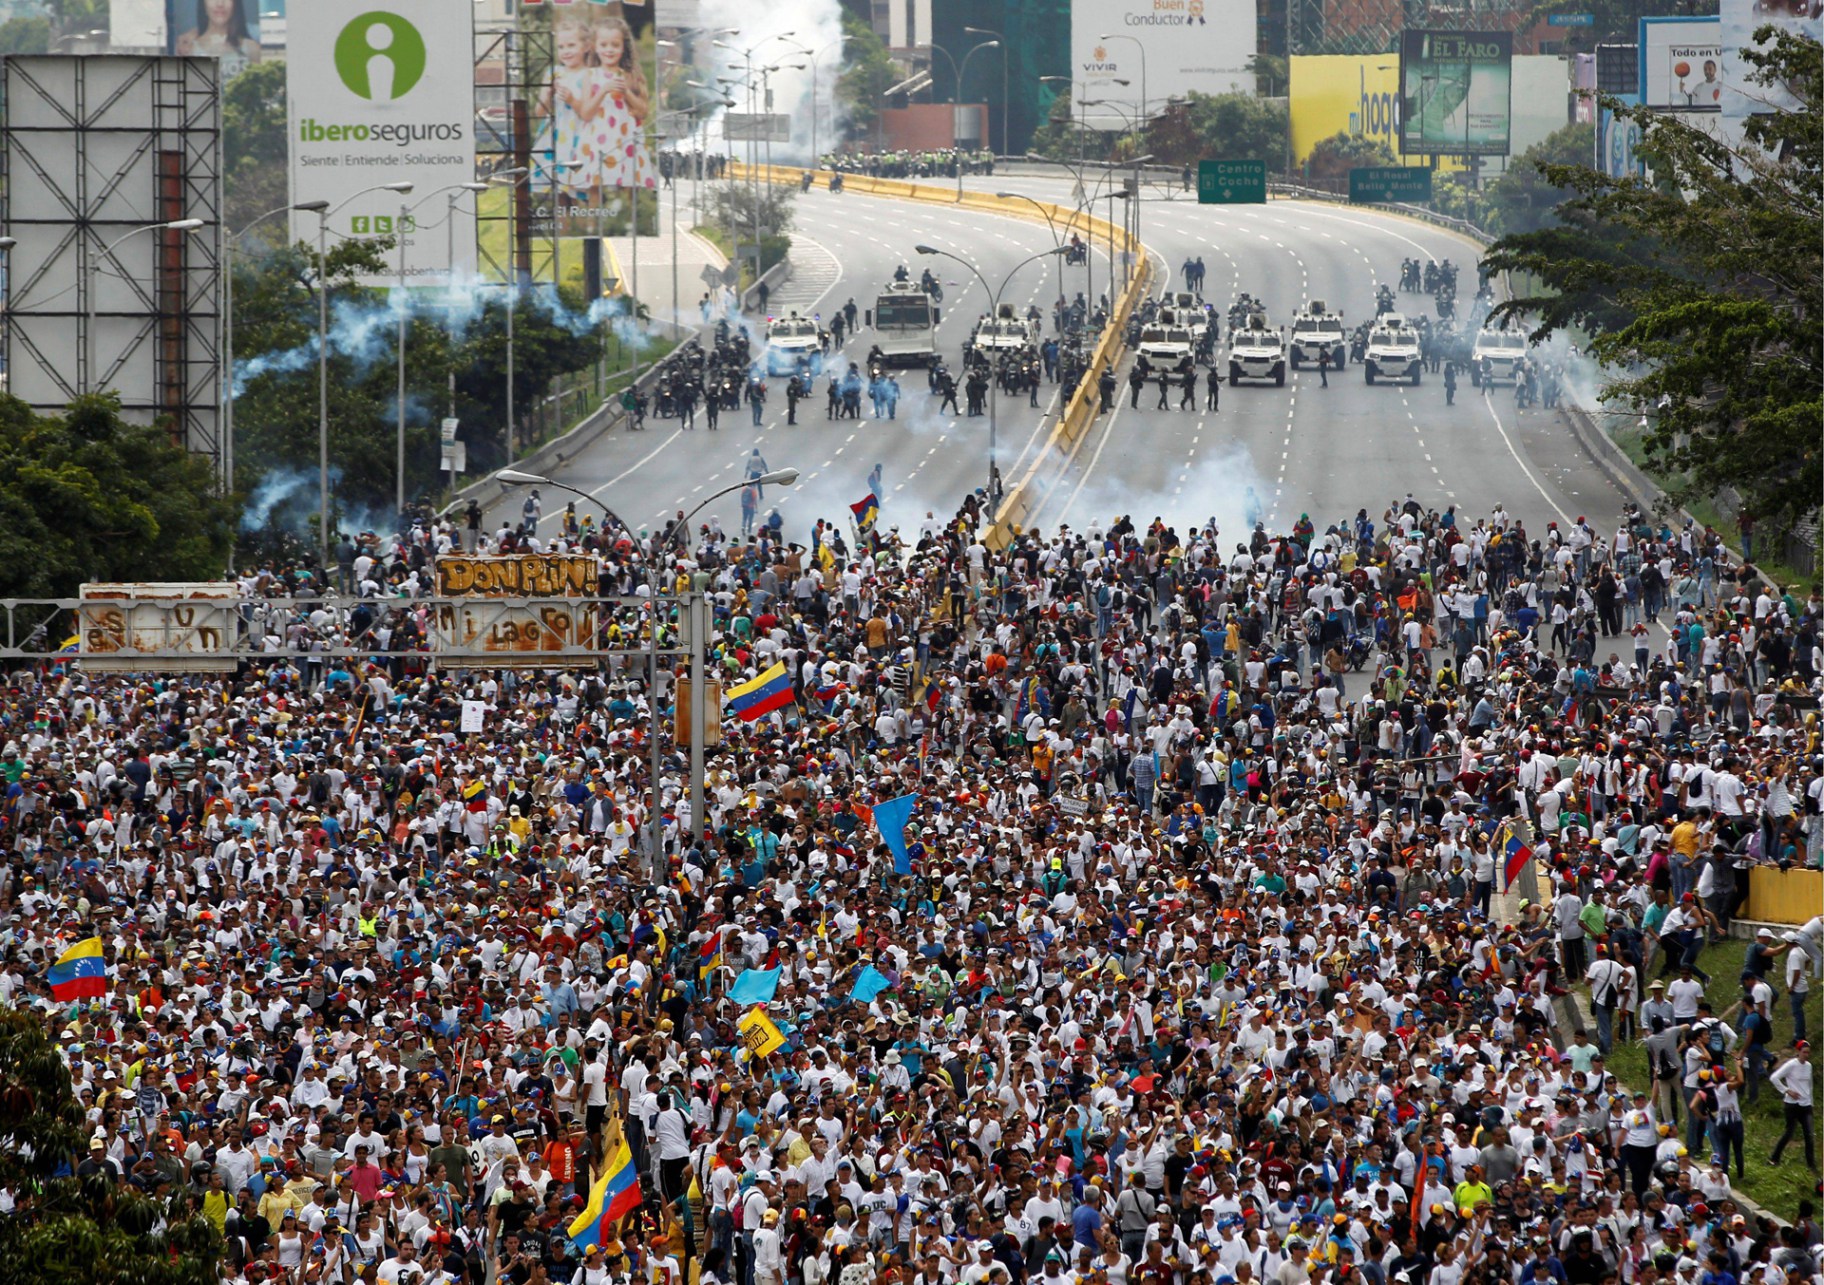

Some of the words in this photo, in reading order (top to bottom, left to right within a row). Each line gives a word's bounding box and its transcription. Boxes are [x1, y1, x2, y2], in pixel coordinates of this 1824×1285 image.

[1124, 12, 1185, 26] Conductor
[1432, 41, 1452, 57] EL
[1457, 41, 1500, 58] FARO
[1672, 49, 1696, 58] Todo
[1083, 64, 1118, 72] VIVIR
[300, 119, 463, 147] iberoseguros
[300, 155, 339, 167] Siente
[345, 154, 399, 166] Entiende
[404, 153, 464, 166] Soluciona
[1217, 164, 1262, 174] Centro
[1369, 171, 1379, 179] El
[1383, 171, 1411, 179] Rosal
[1218, 176, 1259, 186] Coche
[1358, 181, 1386, 190] Bello
[1391, 181, 1424, 190] Monte
[569, 205, 619, 217] Recreo
[435, 559, 518, 596] DON
[872, 1200, 887, 1209] UC
[1020, 1220, 1031, 1231] 87
